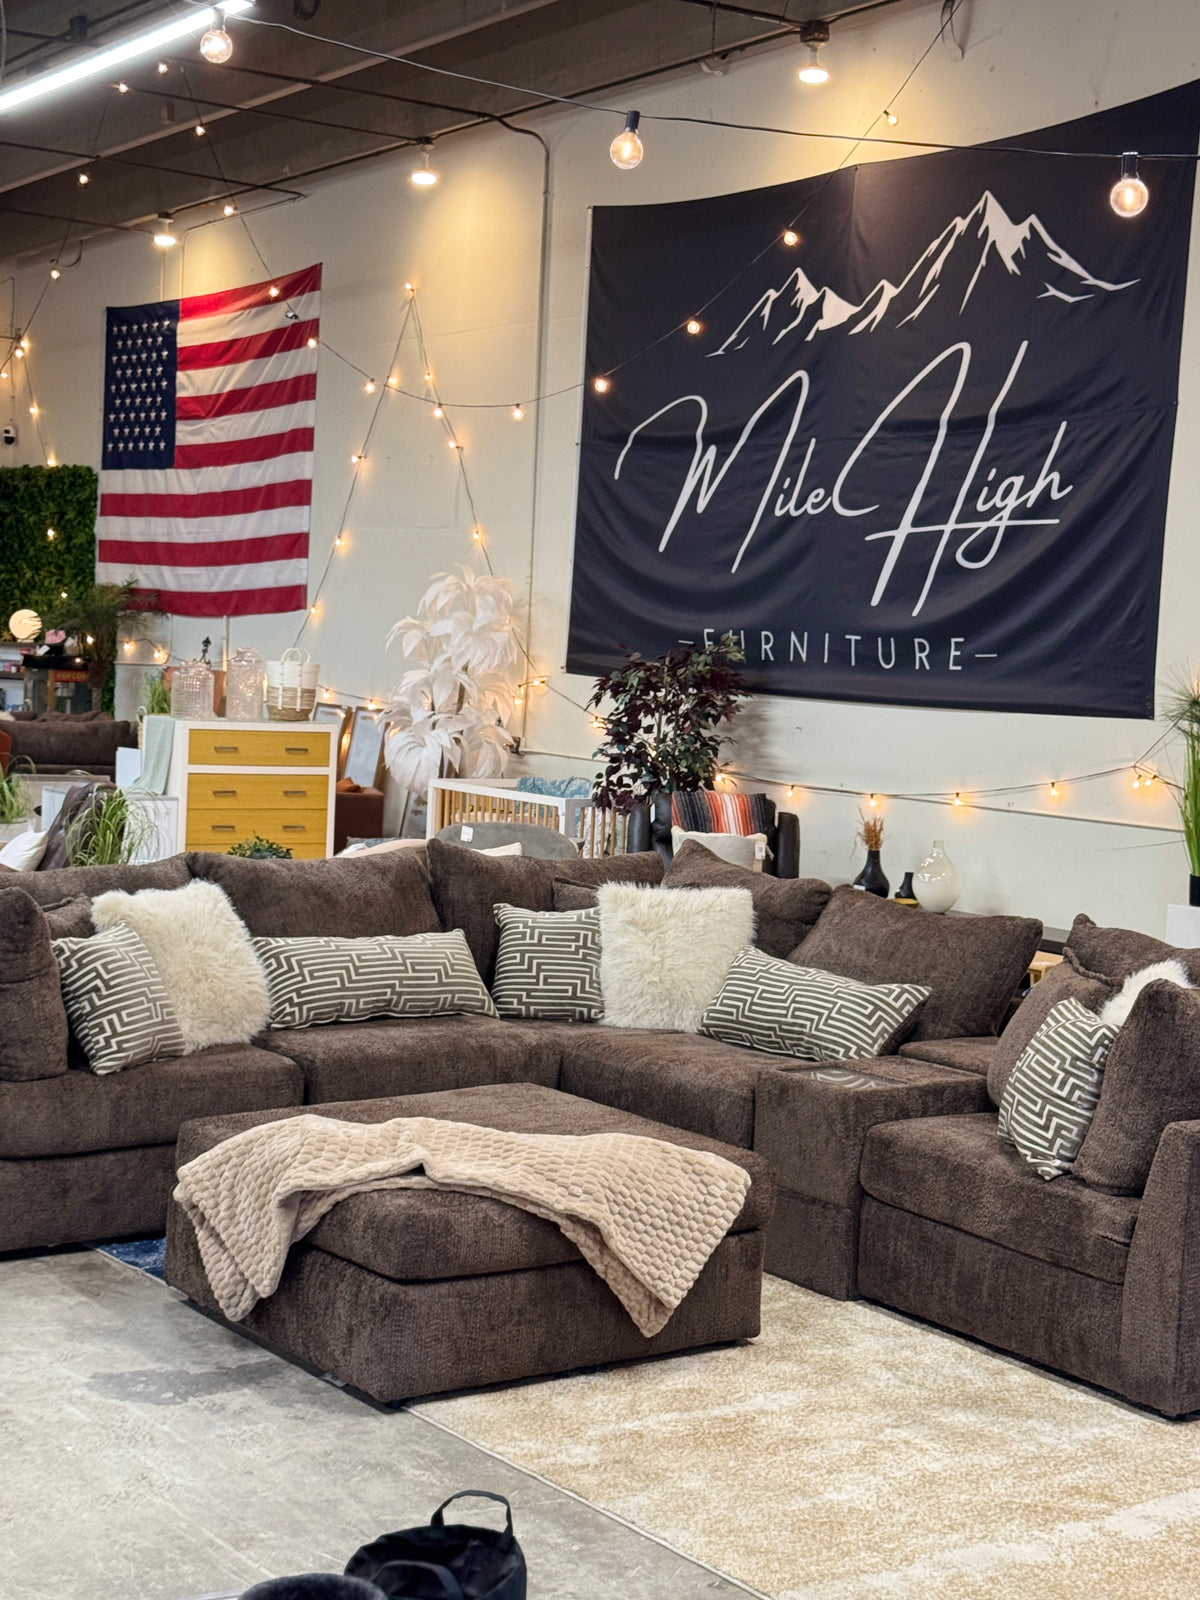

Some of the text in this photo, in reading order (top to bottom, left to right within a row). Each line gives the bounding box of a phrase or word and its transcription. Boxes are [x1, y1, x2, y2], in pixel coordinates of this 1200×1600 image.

[614, 340, 1073, 617] Mile High
[57, 671, 89, 680] POPCOR
